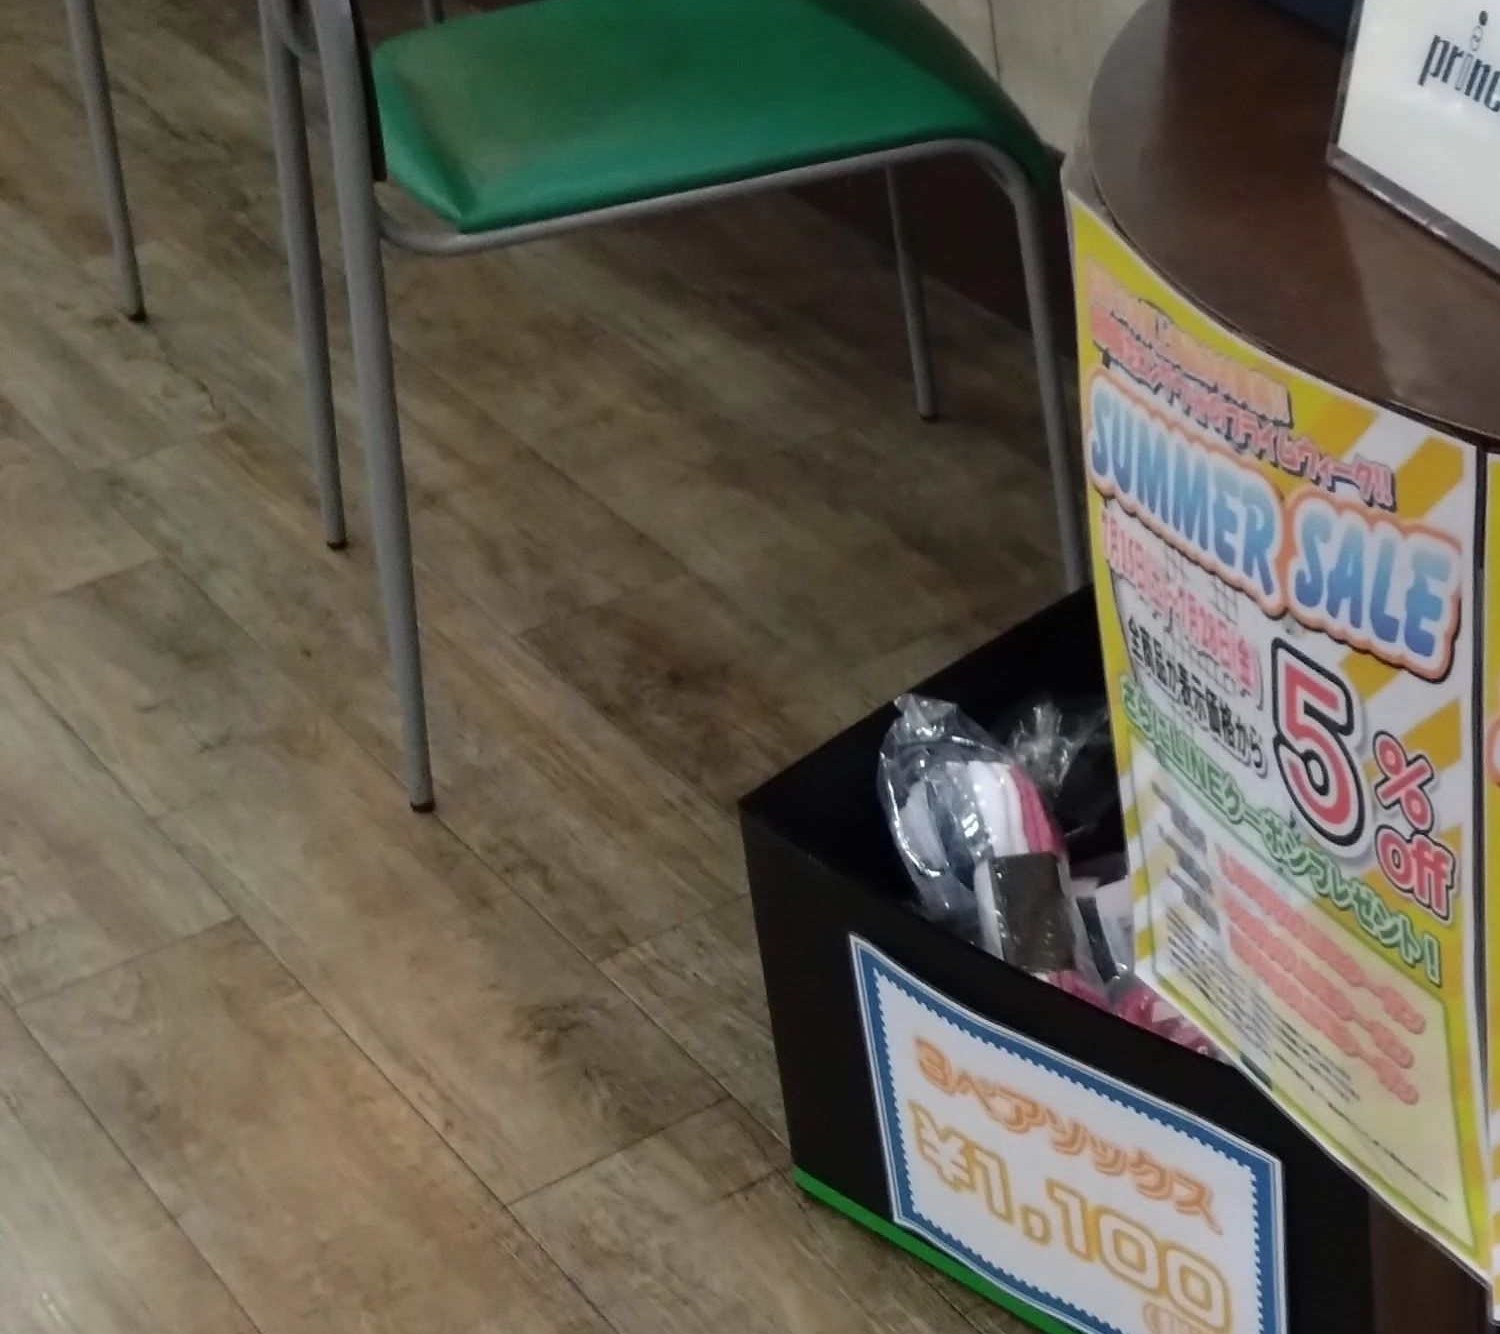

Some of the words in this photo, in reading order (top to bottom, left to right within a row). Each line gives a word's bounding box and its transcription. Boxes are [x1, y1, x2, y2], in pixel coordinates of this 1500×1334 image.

[1088, 380, 1282, 602] SUMMER
[1289, 505, 1456, 663] SALE
[1272, 638, 1366, 846] 5
[913, 1035, 1223, 1235] 3ペアソックス
